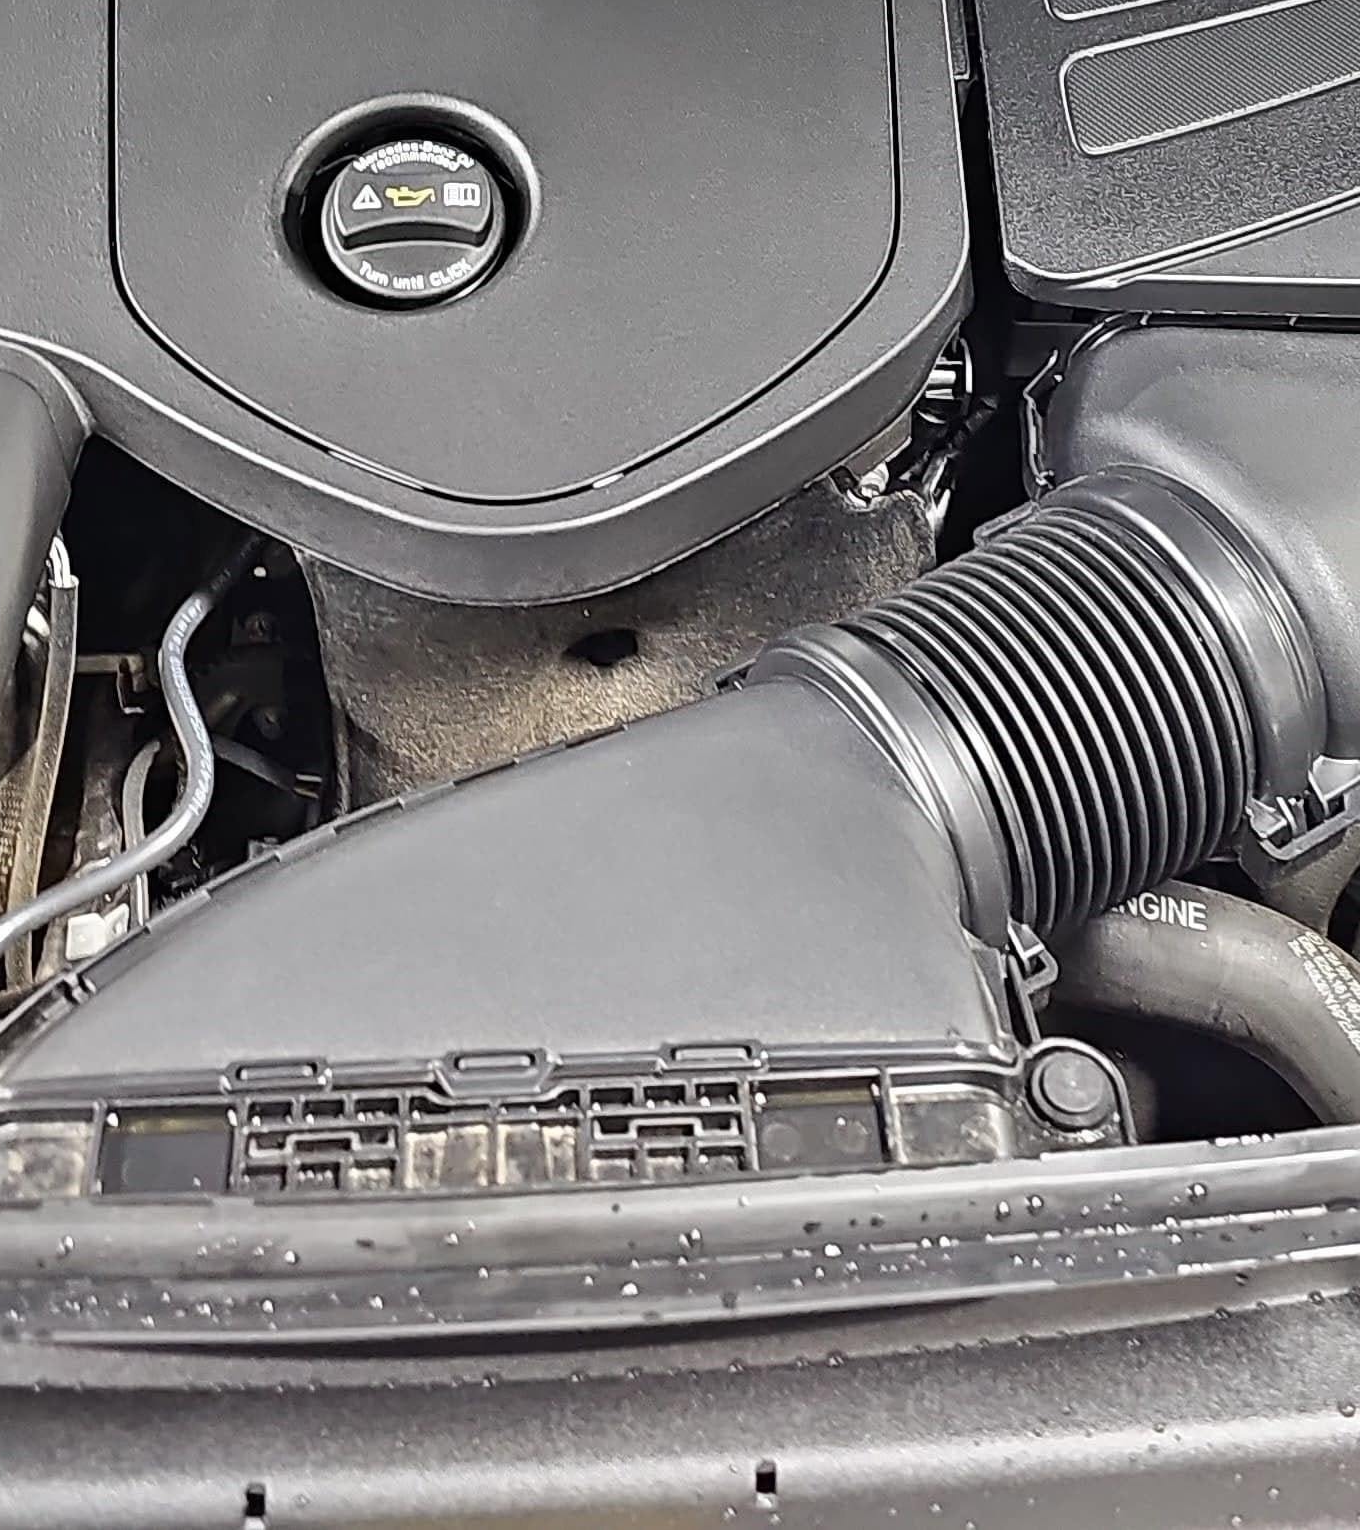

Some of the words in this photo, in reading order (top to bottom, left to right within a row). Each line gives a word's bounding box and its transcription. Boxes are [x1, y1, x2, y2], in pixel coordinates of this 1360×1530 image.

[353, 141, 456, 172] Mercedes-Benz
[371, 150, 460, 173] recommended
[359, 260, 389, 287] Turn
[392, 274, 425, 291] until
[428, 257, 473, 288] CLICK
[1112, 892, 1208, 931] NGINE
